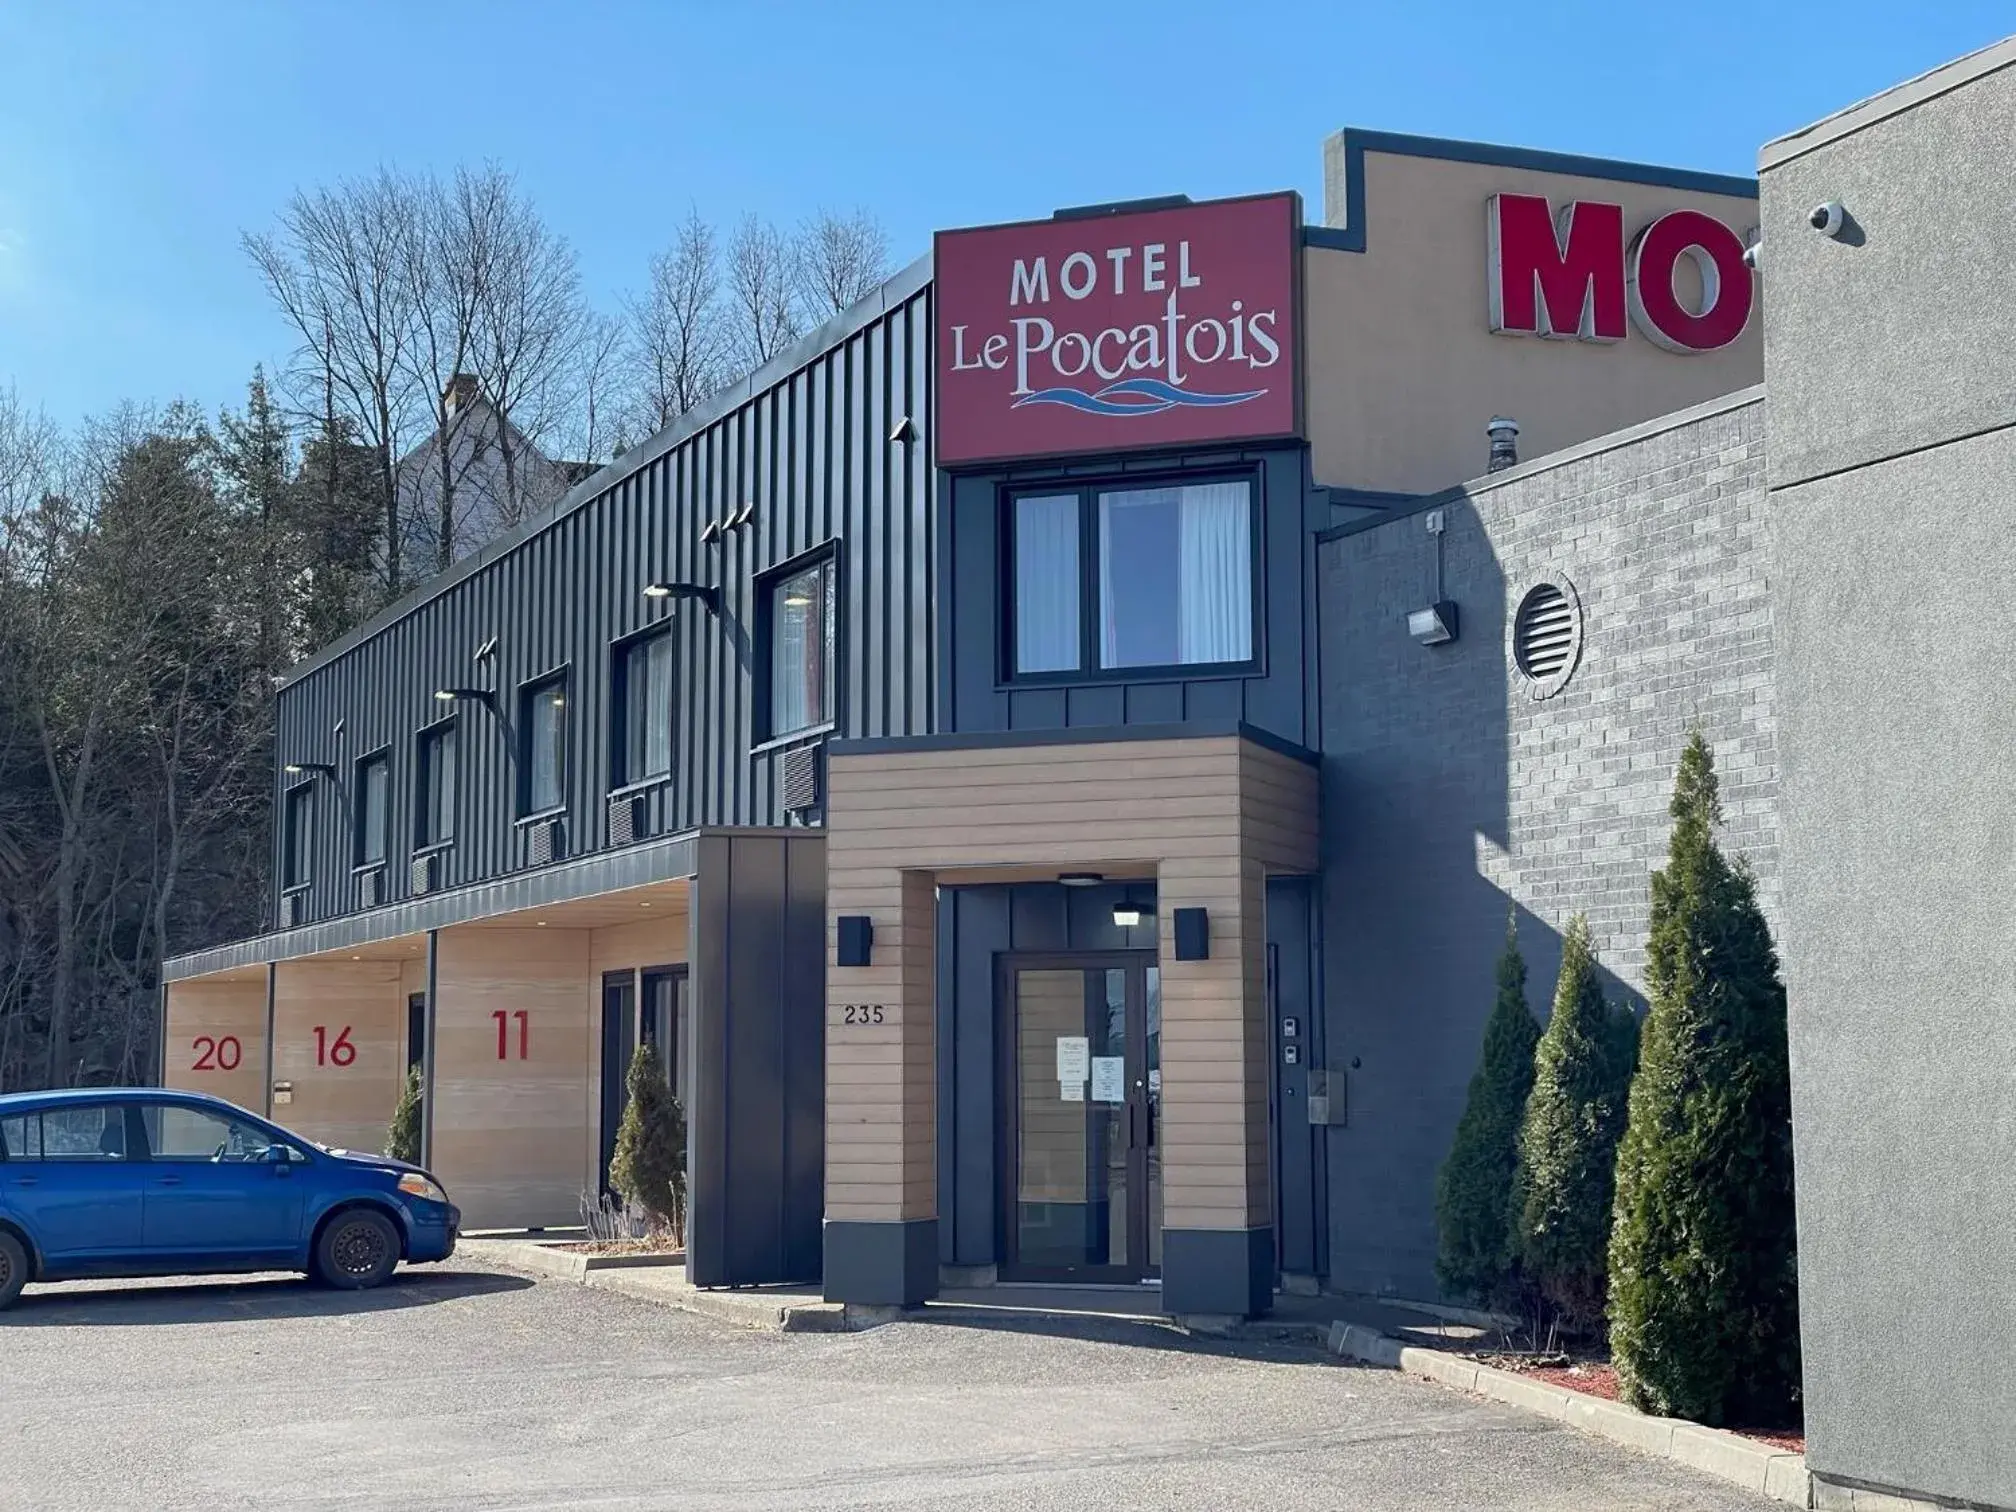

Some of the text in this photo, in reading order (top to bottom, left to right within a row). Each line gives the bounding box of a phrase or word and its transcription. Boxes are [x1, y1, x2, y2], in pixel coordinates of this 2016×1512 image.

[1010, 240, 1201, 305] MOTEL
[1494, 192, 1758, 352] MO
[950, 286, 1280, 396] Le Pocatois
[491, 1010, 529, 1060] 11
[845, 1005, 883, 1024] 235
[192, 1036, 241, 1070] 20
[312, 1025, 357, 1067] 16
